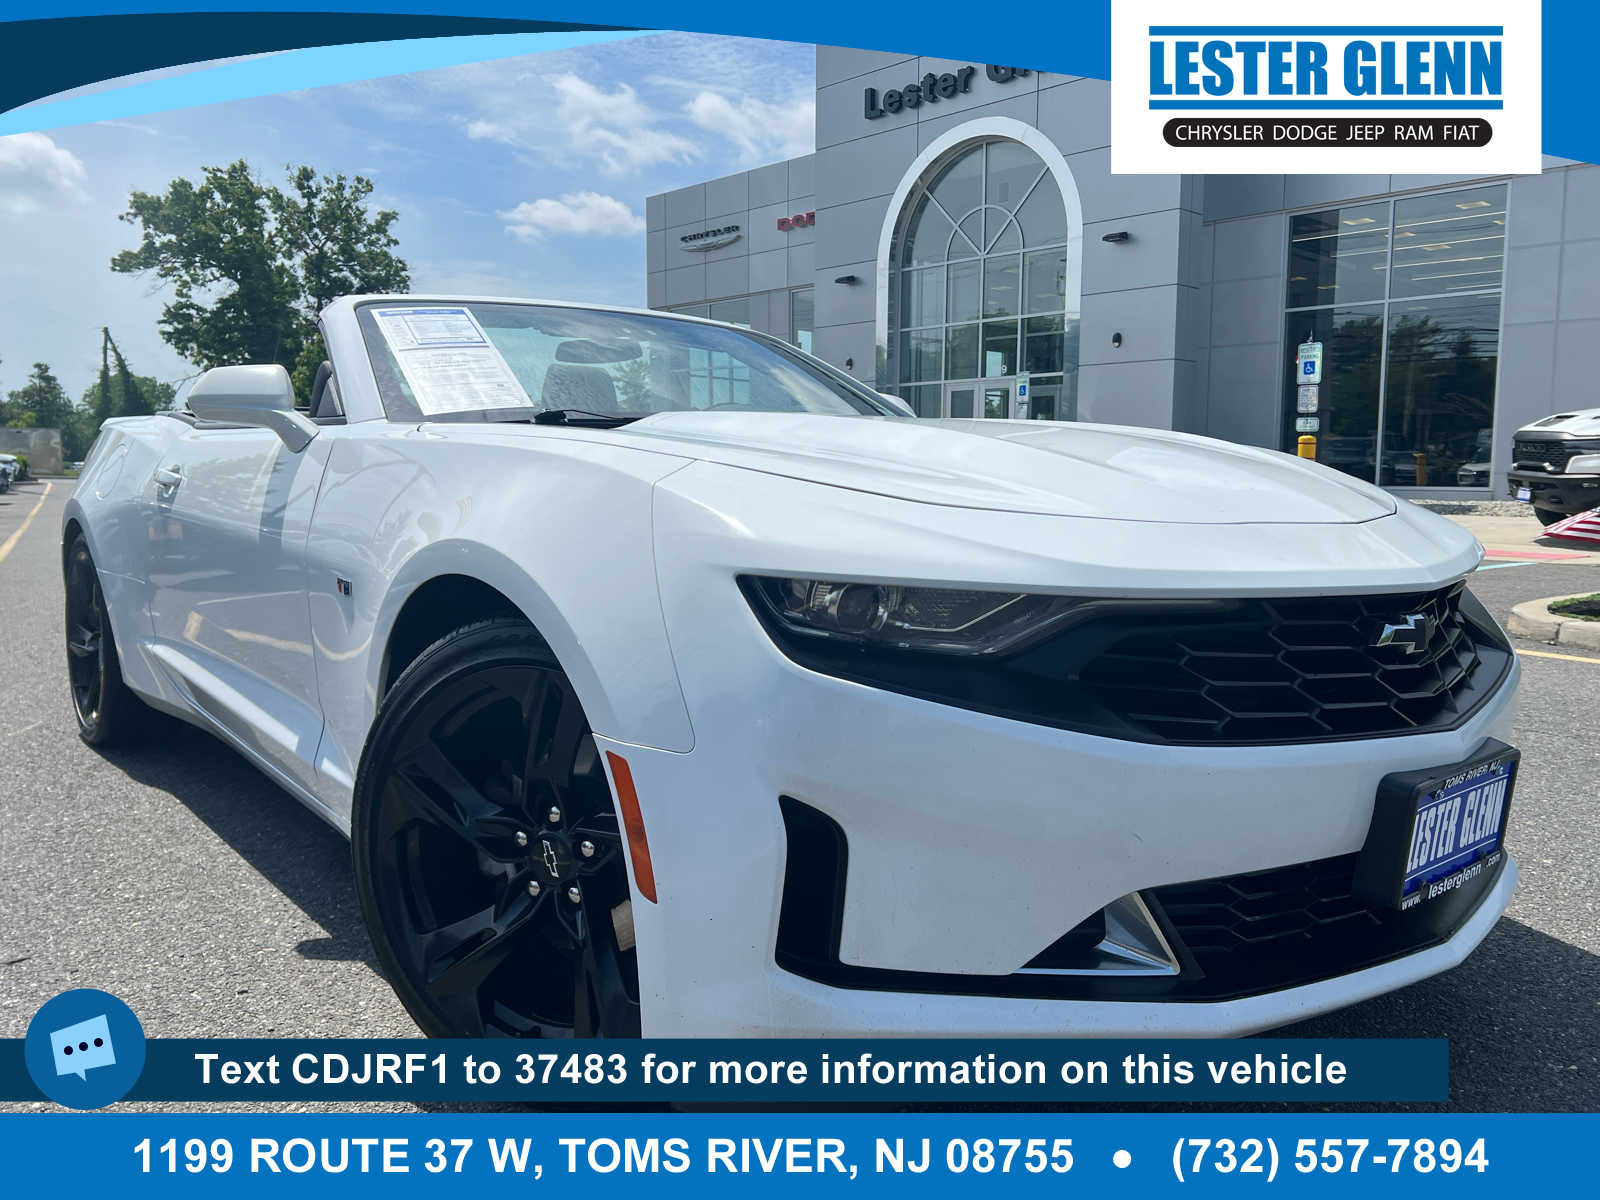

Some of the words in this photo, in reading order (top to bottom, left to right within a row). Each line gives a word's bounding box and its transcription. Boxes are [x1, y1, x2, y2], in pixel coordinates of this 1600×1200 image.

[864, 65, 975, 120] Lester
[1444, 773, 1467, 789] TOMS
[1406, 797, 1462, 873] LESTER
[1460, 778, 1508, 849] GLENN
